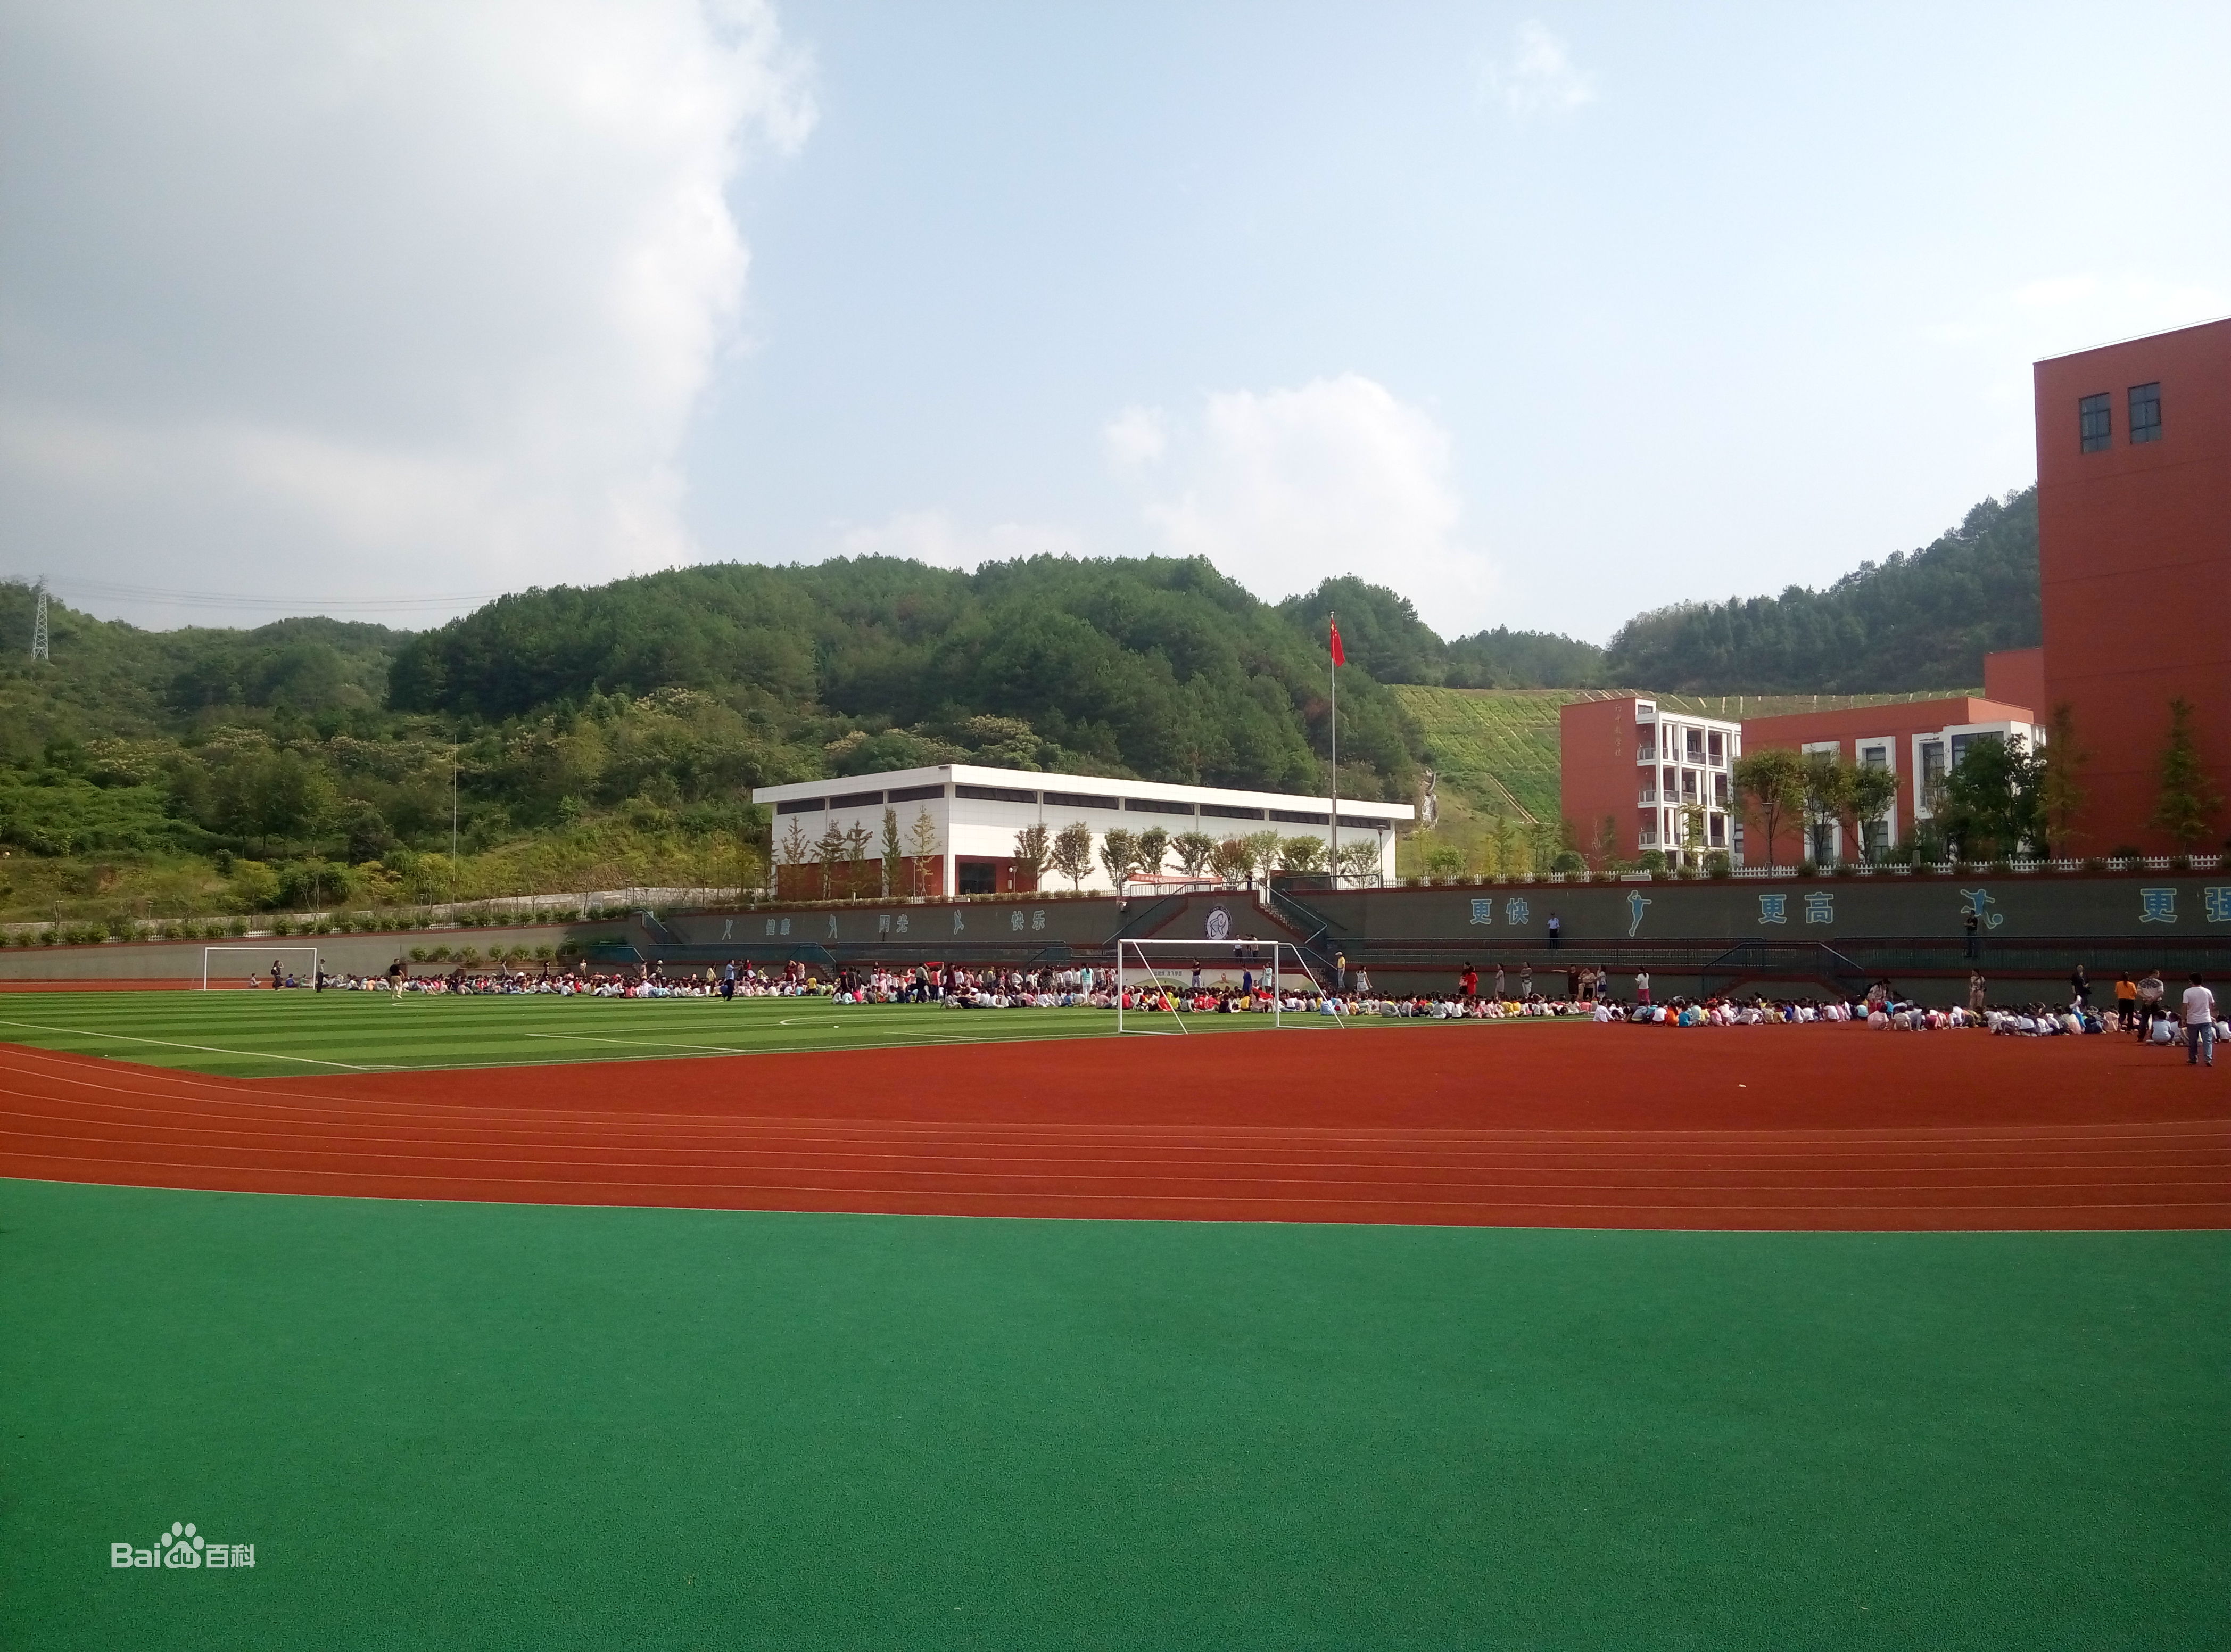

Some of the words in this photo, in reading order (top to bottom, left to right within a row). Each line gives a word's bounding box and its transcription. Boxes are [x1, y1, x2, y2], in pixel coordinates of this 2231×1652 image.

[765, 918, 791, 935] 健康
[878, 914, 909, 933] 阳光
[1011, 910, 1045, 931] 快乐
[1470, 898, 1529, 925] 更快
[1758, 891, 1834, 924] 更高
